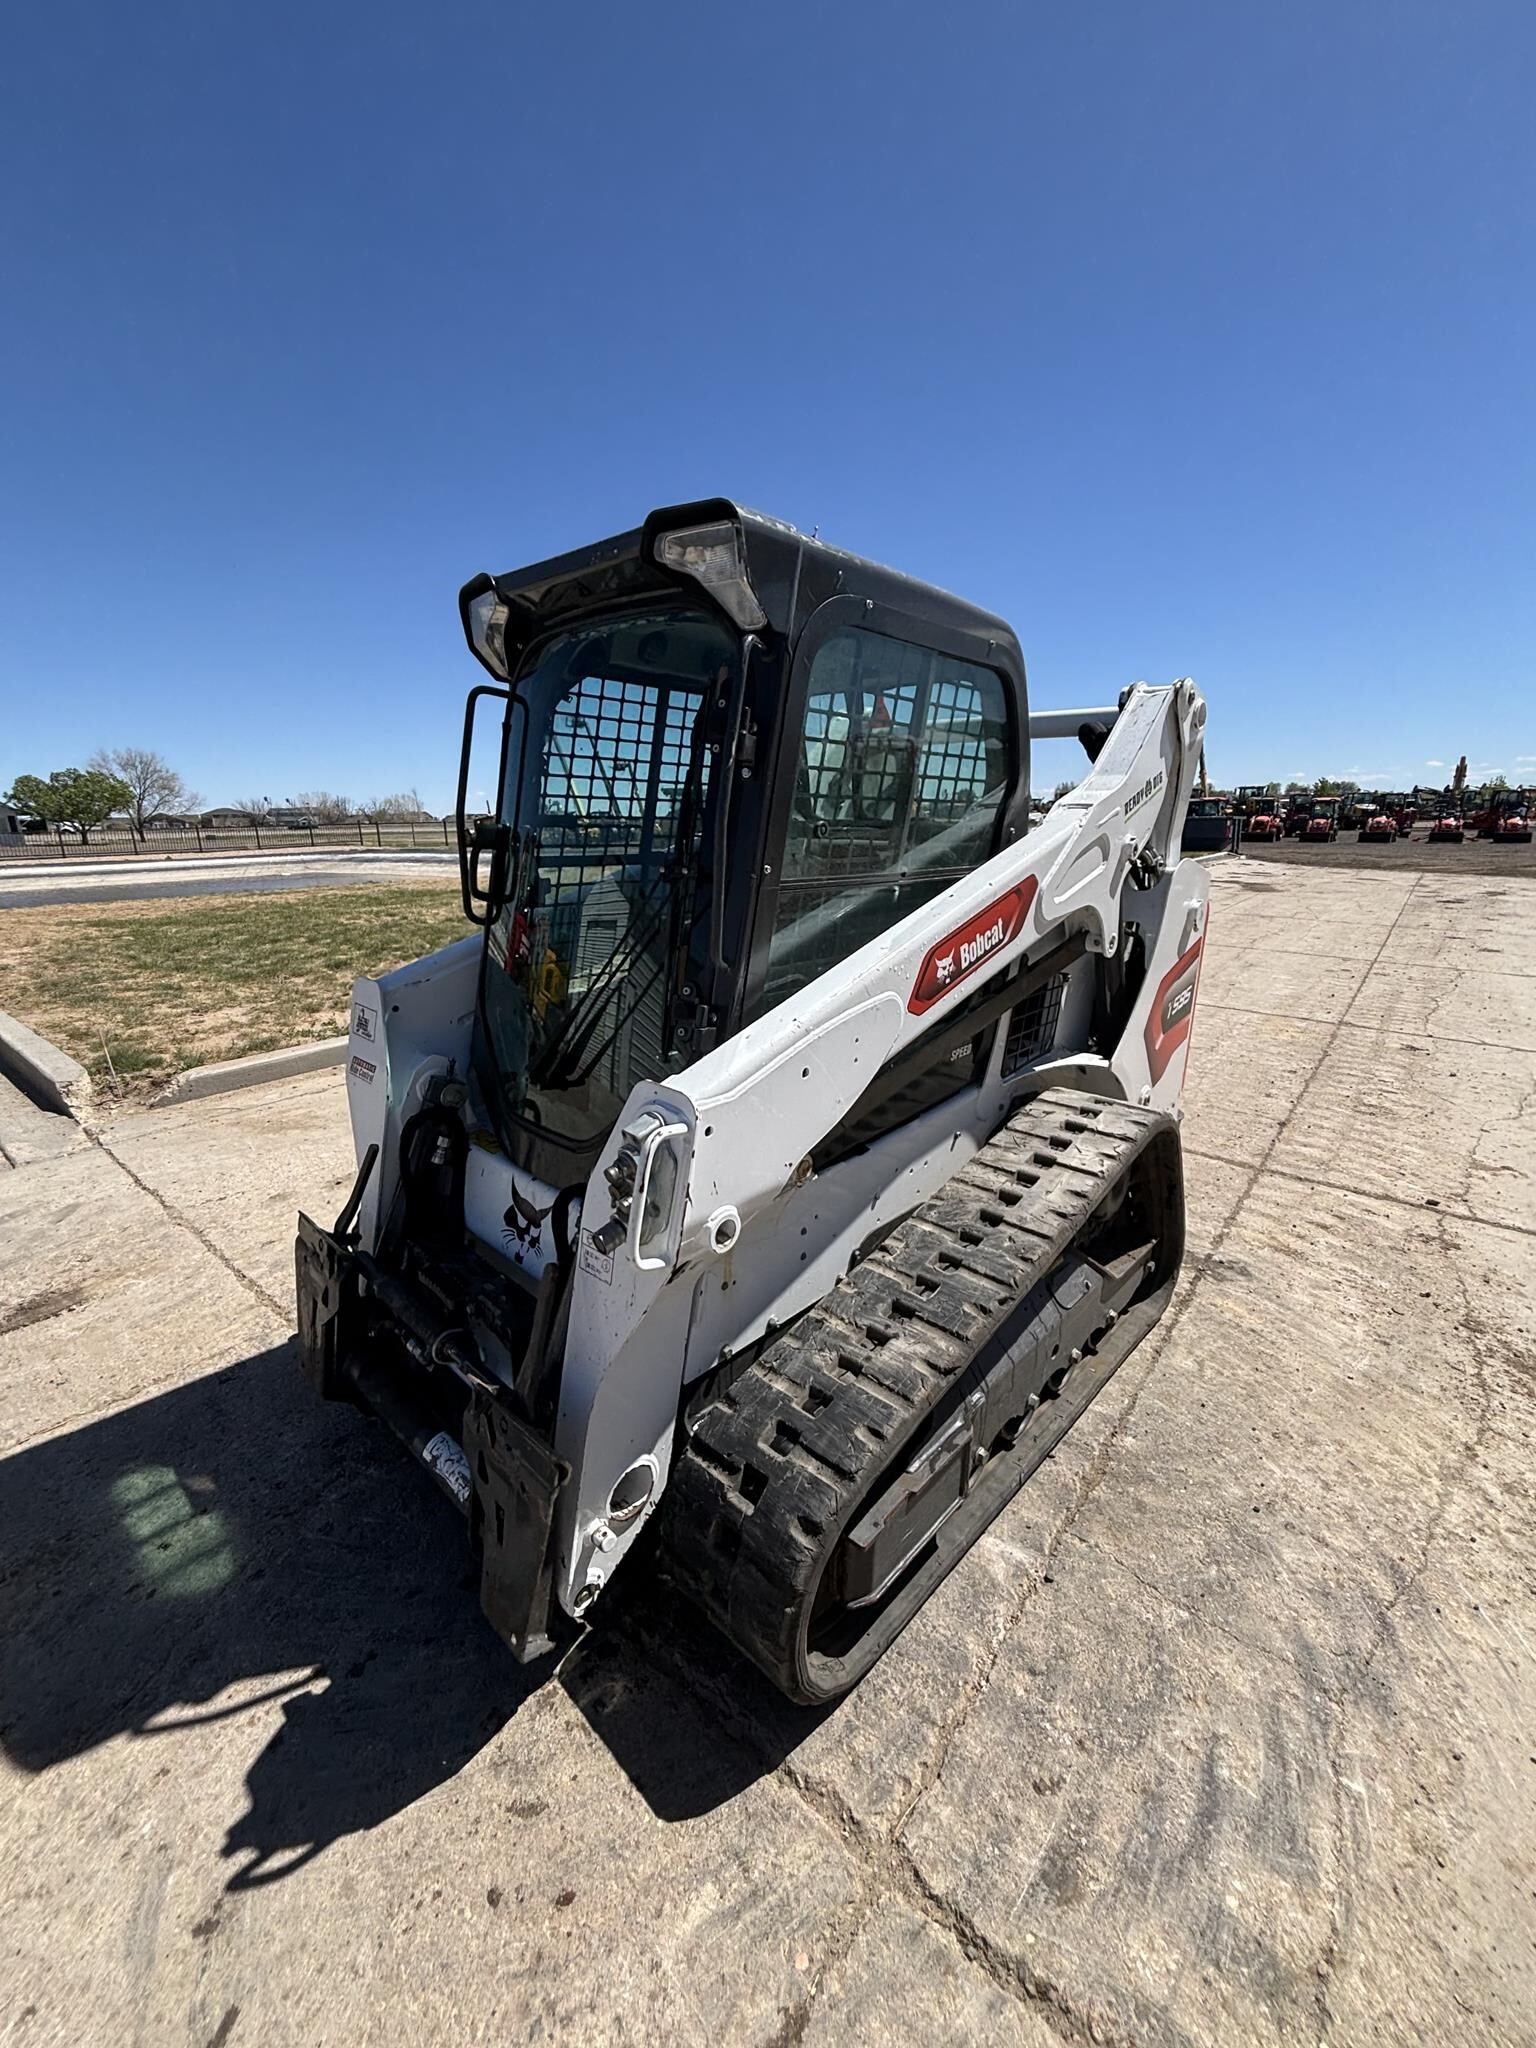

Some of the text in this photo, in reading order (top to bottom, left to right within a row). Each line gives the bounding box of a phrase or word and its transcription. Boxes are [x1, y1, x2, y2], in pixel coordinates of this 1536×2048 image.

[959, 917, 1004, 970] Bobcat
[950, 1043, 973, 1062] SPEED
[358, 1068, 375, 1083] Control
